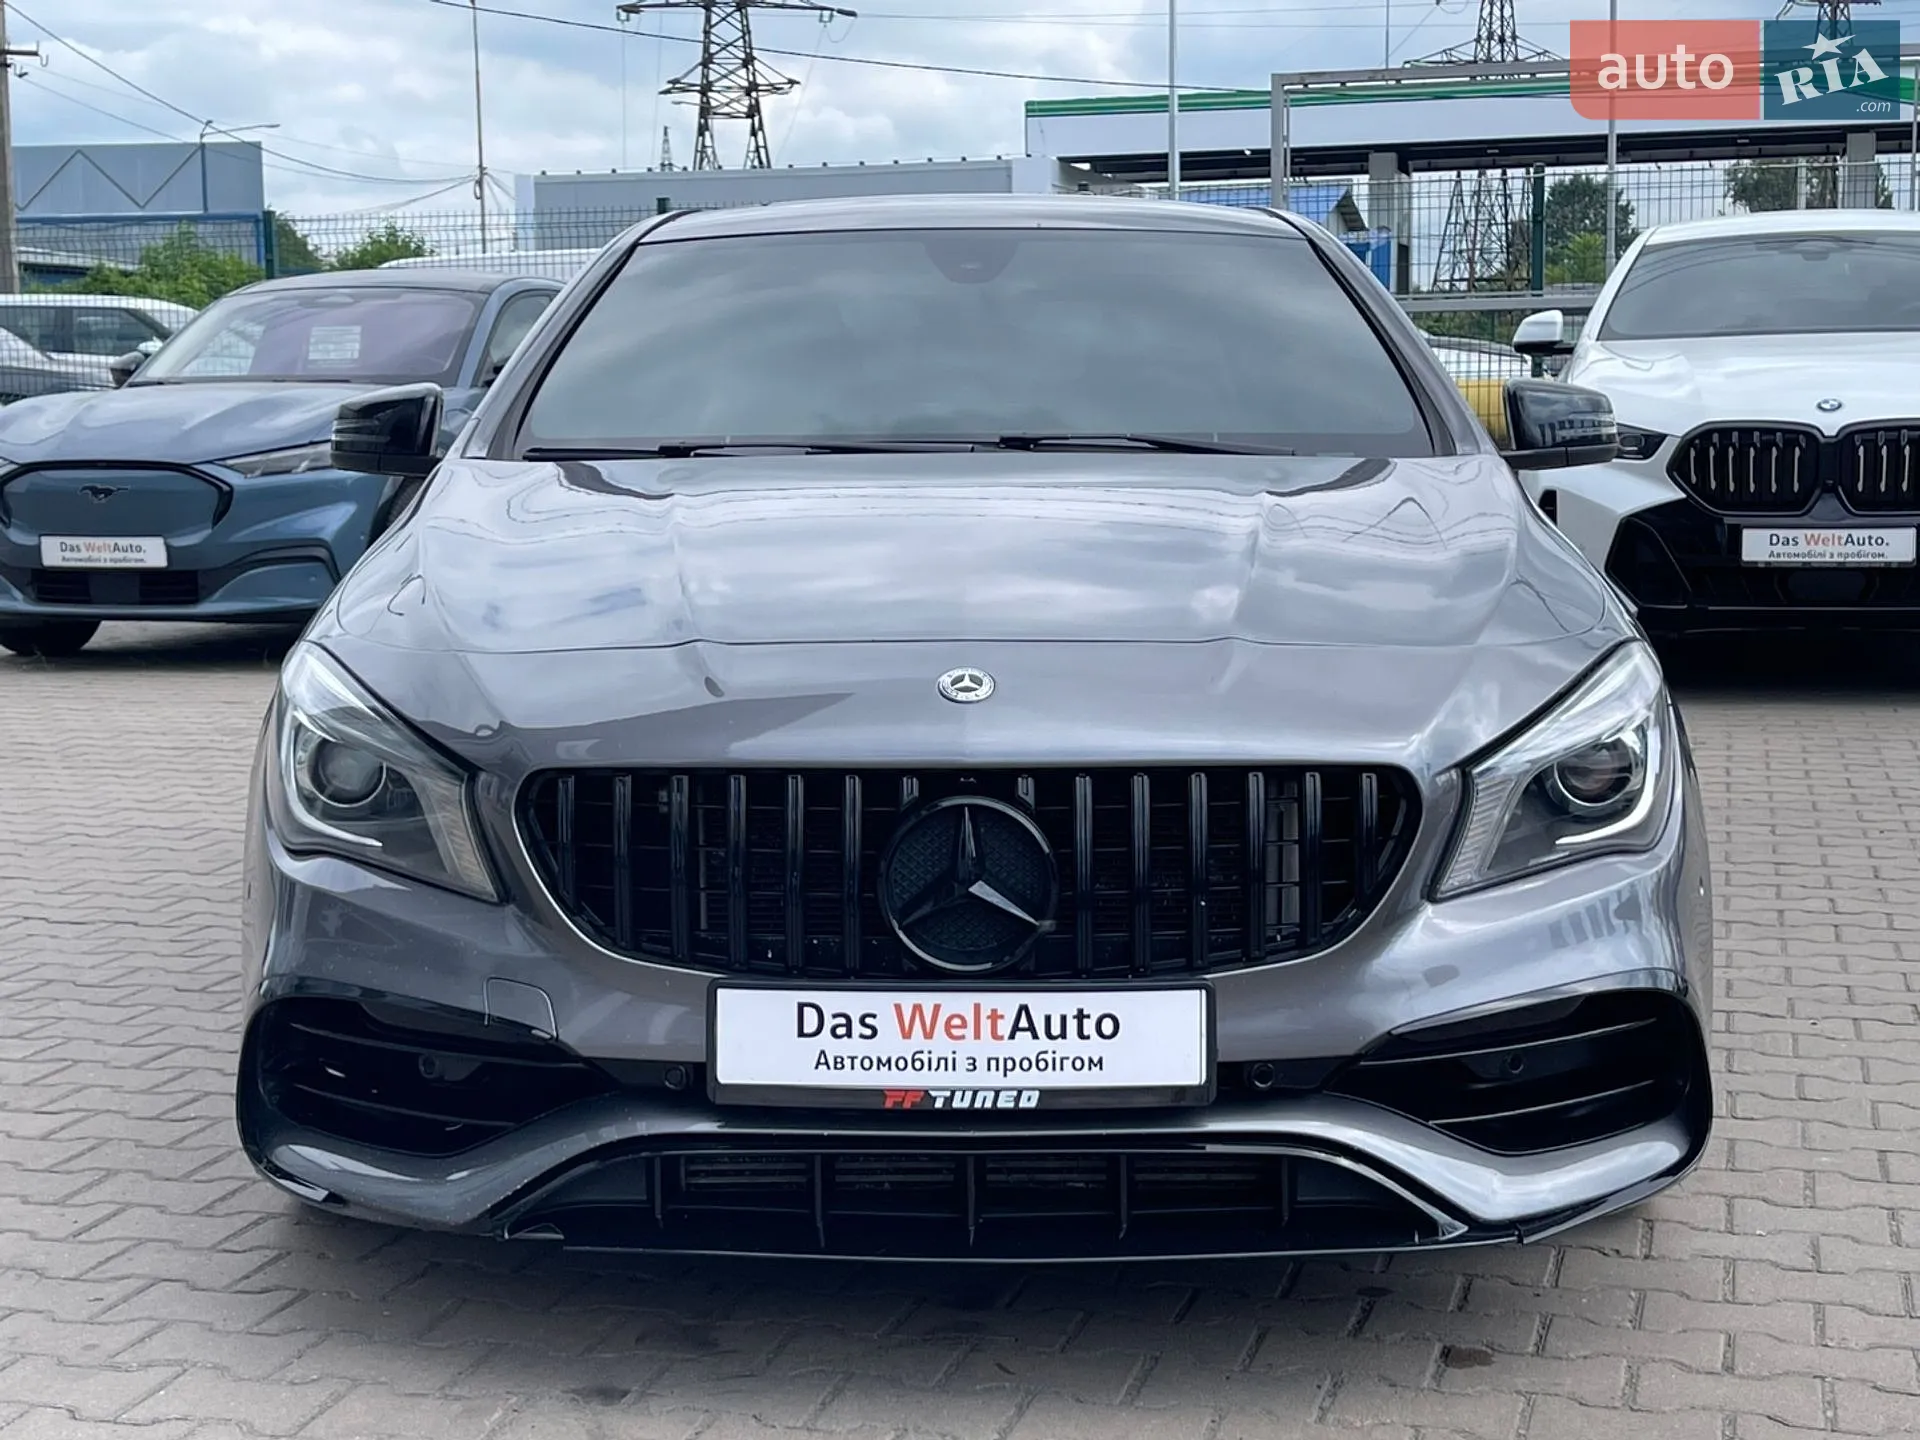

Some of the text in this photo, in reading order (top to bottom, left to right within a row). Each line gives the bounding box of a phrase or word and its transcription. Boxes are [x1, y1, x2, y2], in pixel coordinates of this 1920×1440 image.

[60, 541, 82, 553] Das
[1769, 533, 1890, 547] Das WeltAuto.
[796, 1001, 1121, 1042] Das WeltAuto
[813, 1048, 1104, 1079] Автомобілі з пробігом
